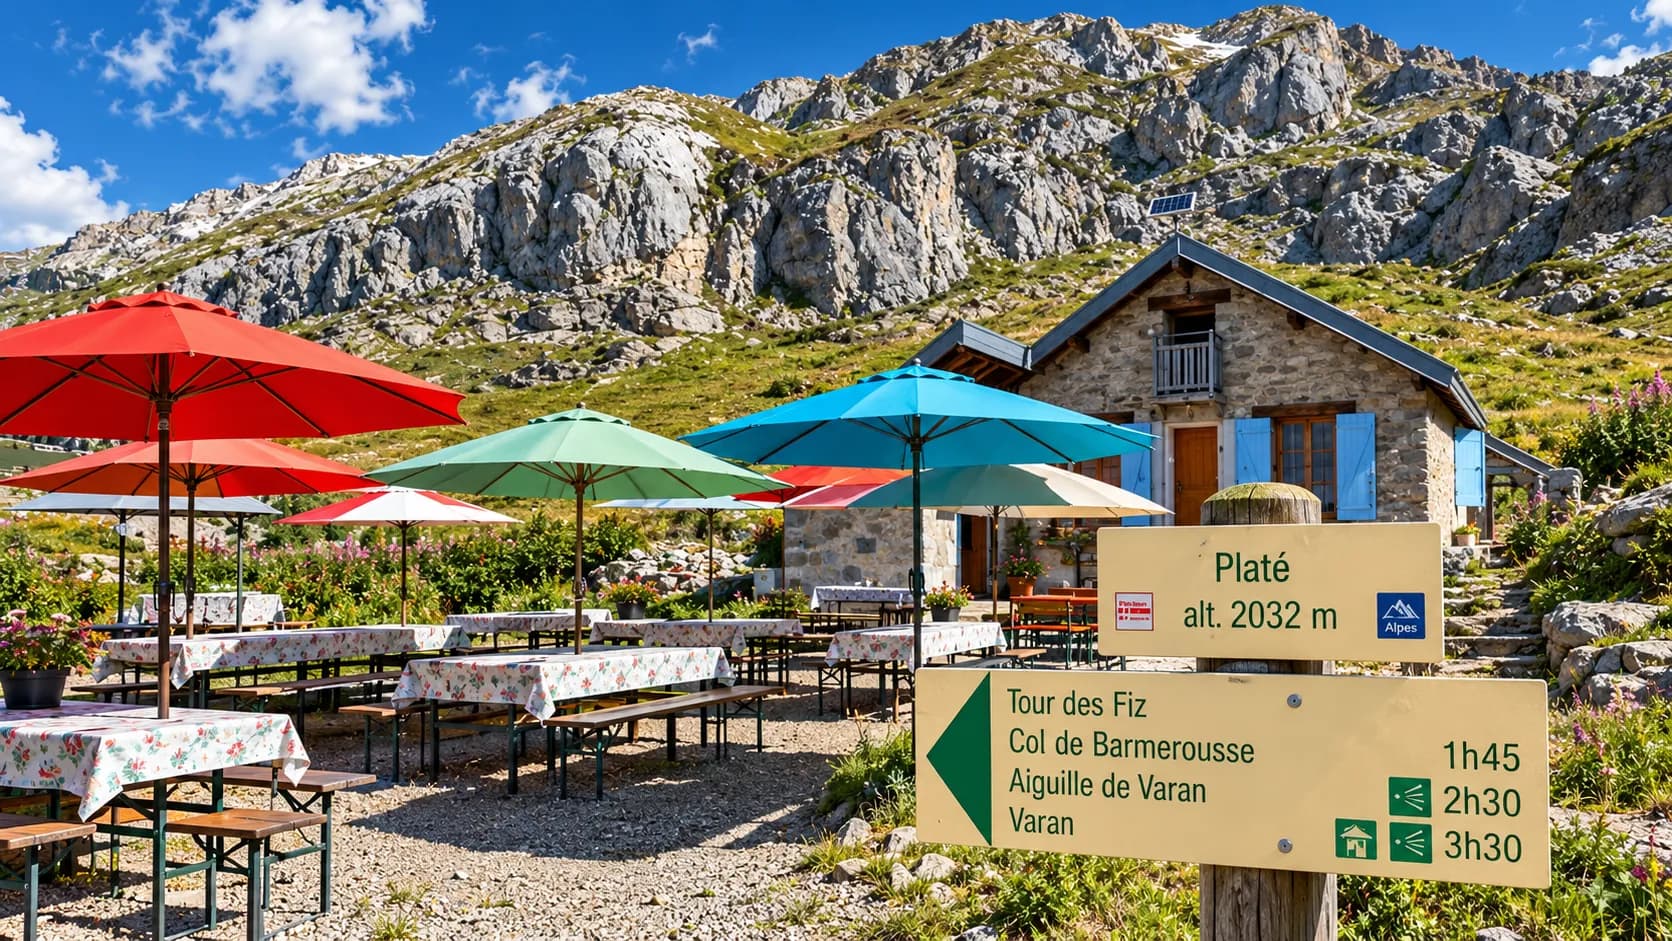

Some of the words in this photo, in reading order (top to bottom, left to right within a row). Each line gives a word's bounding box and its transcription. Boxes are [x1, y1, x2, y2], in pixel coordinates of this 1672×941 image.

[1215, 551, 1290, 583] Platé
[1183, 599, 1222, 629] alt.
[1231, 600, 1301, 630] 2032
[1312, 607, 1337, 630] m
[1384, 621, 1418, 636] Alpes
[1006, 688, 1056, 715] Tour
[1062, 689, 1104, 717] des
[1113, 691, 1147, 718] Fiz
[1009, 727, 1046, 755] Col
[1055, 729, 1083, 756] de
[1093, 730, 1255, 764] Barmerousse
[1443, 740, 1521, 772] 1h45
[1008, 767, 1094, 801] Aiguille
[1101, 771, 1130, 799] de
[1137, 773, 1206, 803] Varan
[1443, 785, 1521, 818] 2h30
[1008, 806, 1074, 836] Varan
[1444, 830, 1522, 863] 3h30
